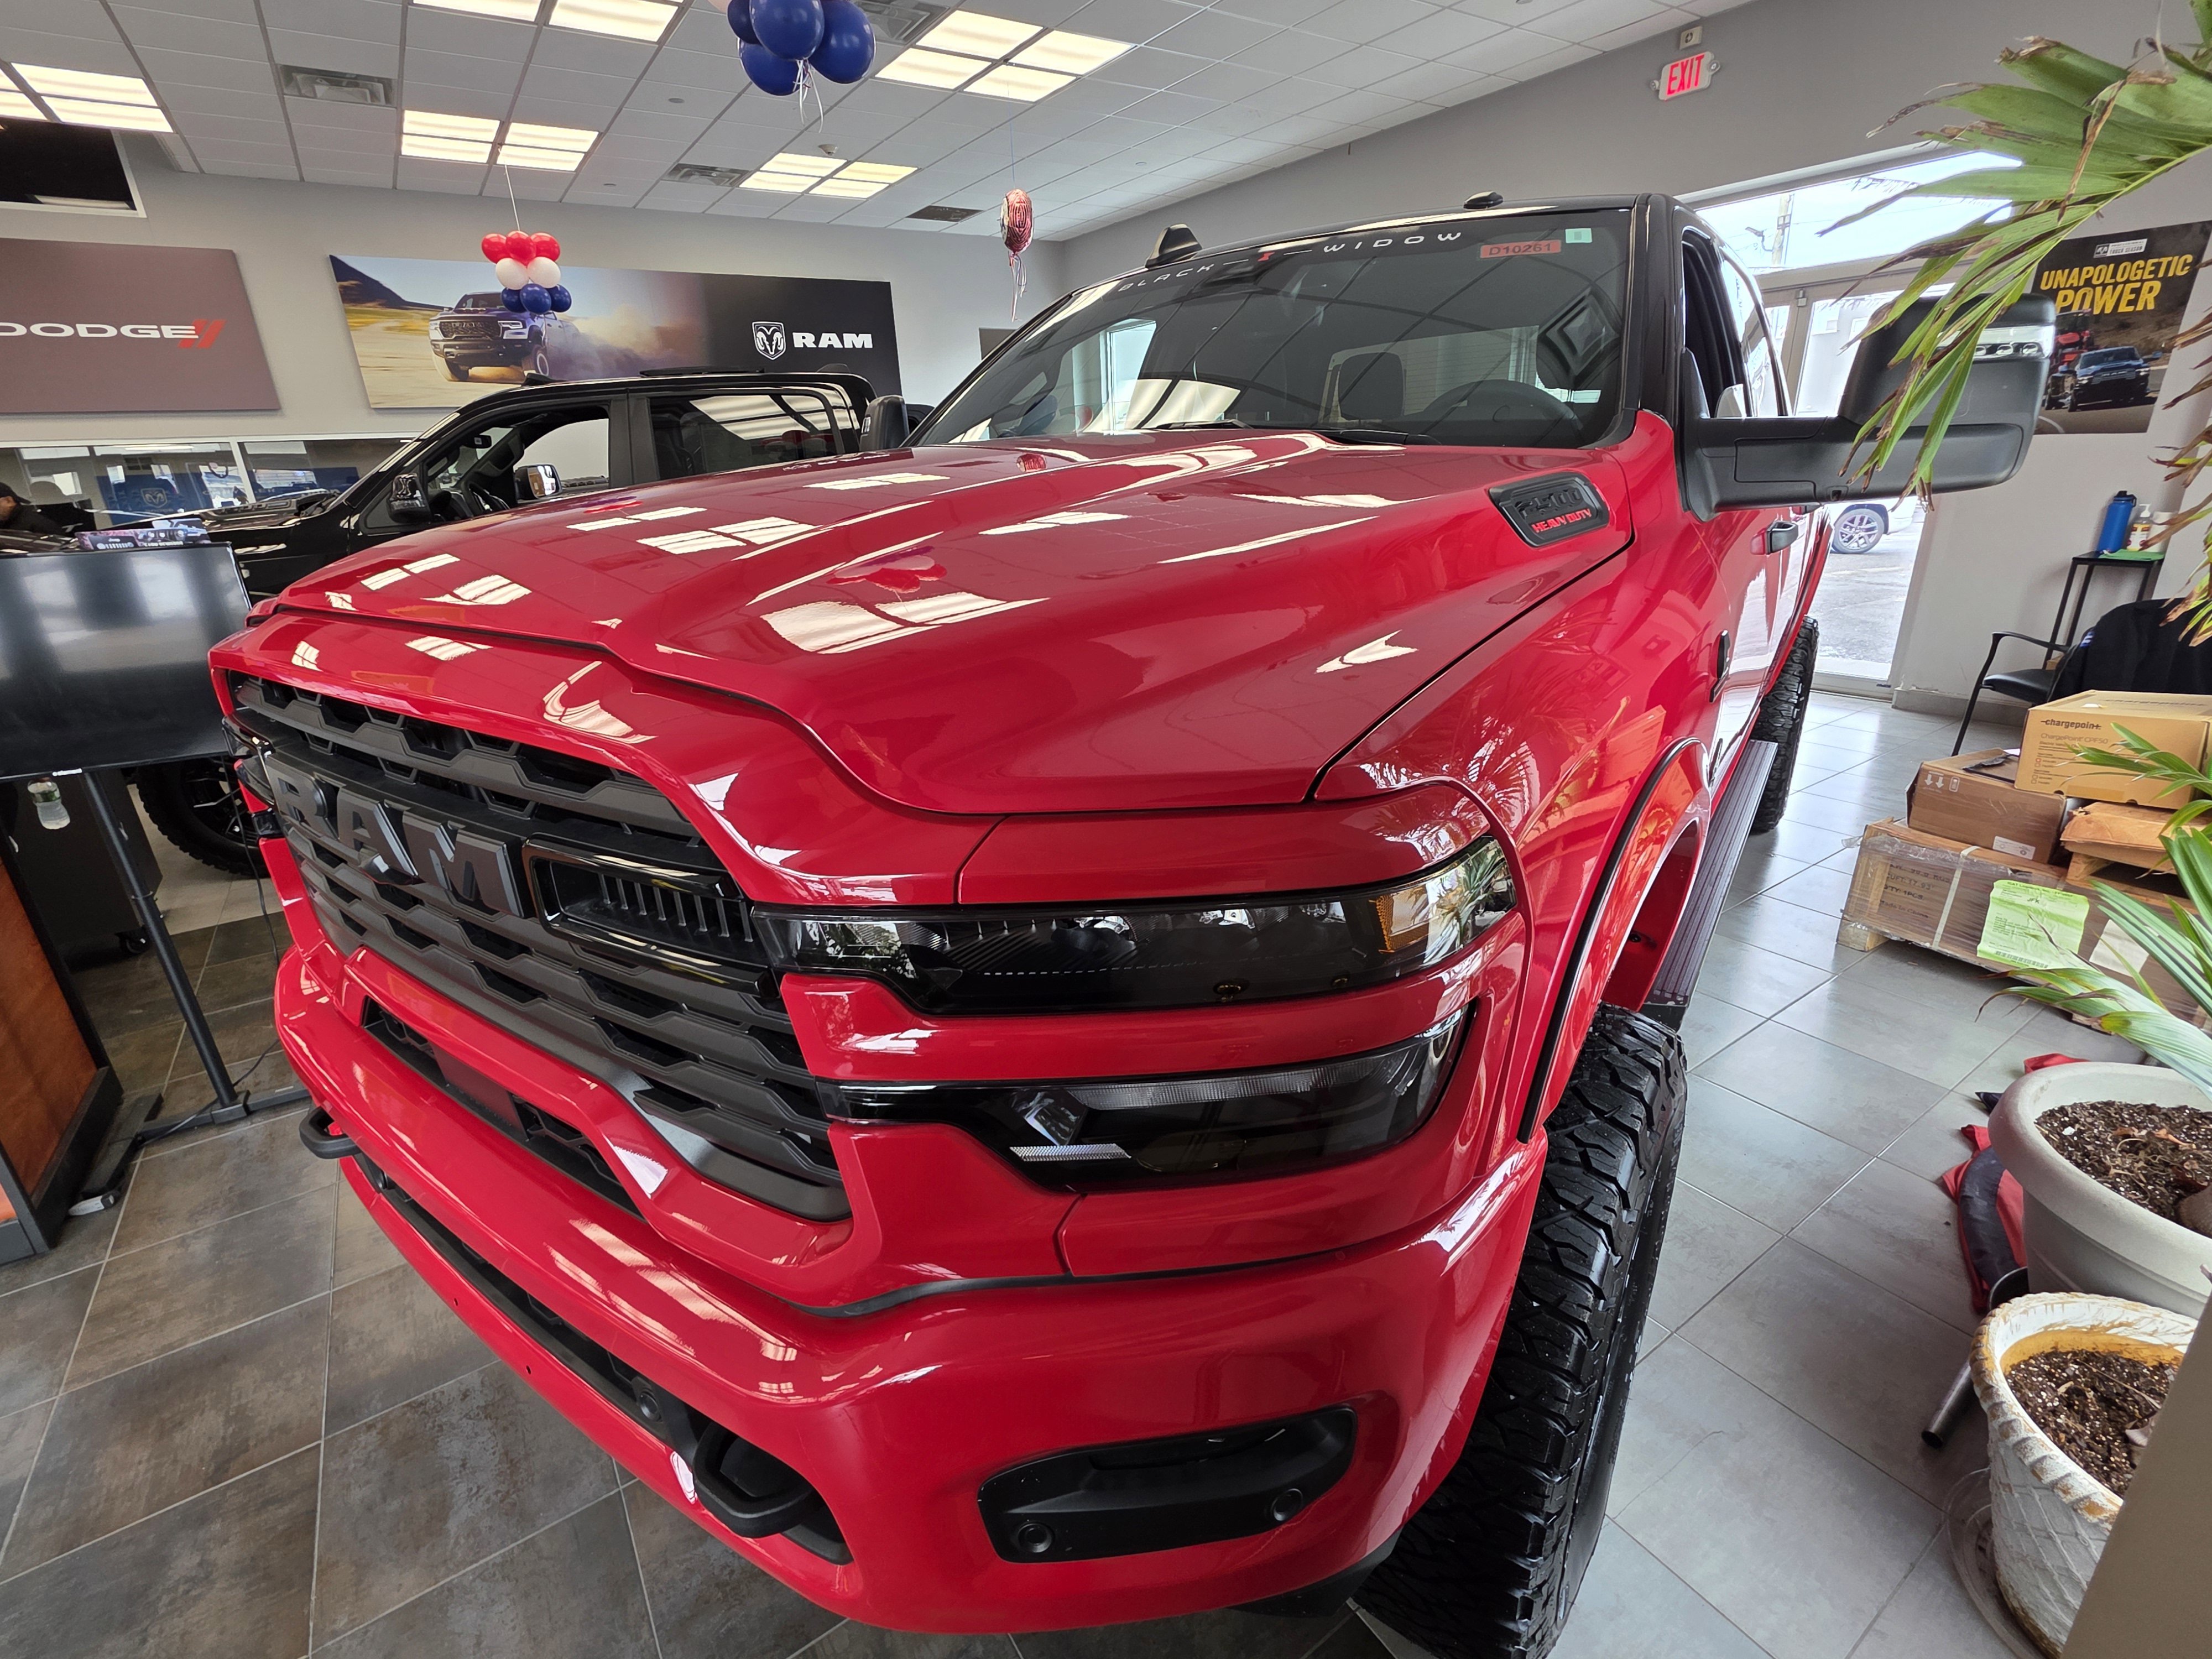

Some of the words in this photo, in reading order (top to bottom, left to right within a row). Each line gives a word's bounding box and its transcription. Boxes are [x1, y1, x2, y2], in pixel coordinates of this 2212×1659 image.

[1667, 54, 1705, 96] EXIT
[1119, 263, 1214, 291] BLACK
[1324, 232, 1462, 253] WIDOW
[1488, 243, 1552, 256] D10261
[2040, 254, 2193, 290] UNAPOLOGETIC
[2055, 280, 2162, 315] POWER
[0, 322, 199, 338] DODGE
[792, 332, 873, 348] RAM
[1531, 515, 1567, 533] HEAVY
[1564, 508, 1593, 523] DUTY
[267, 755, 525, 918] RAM
